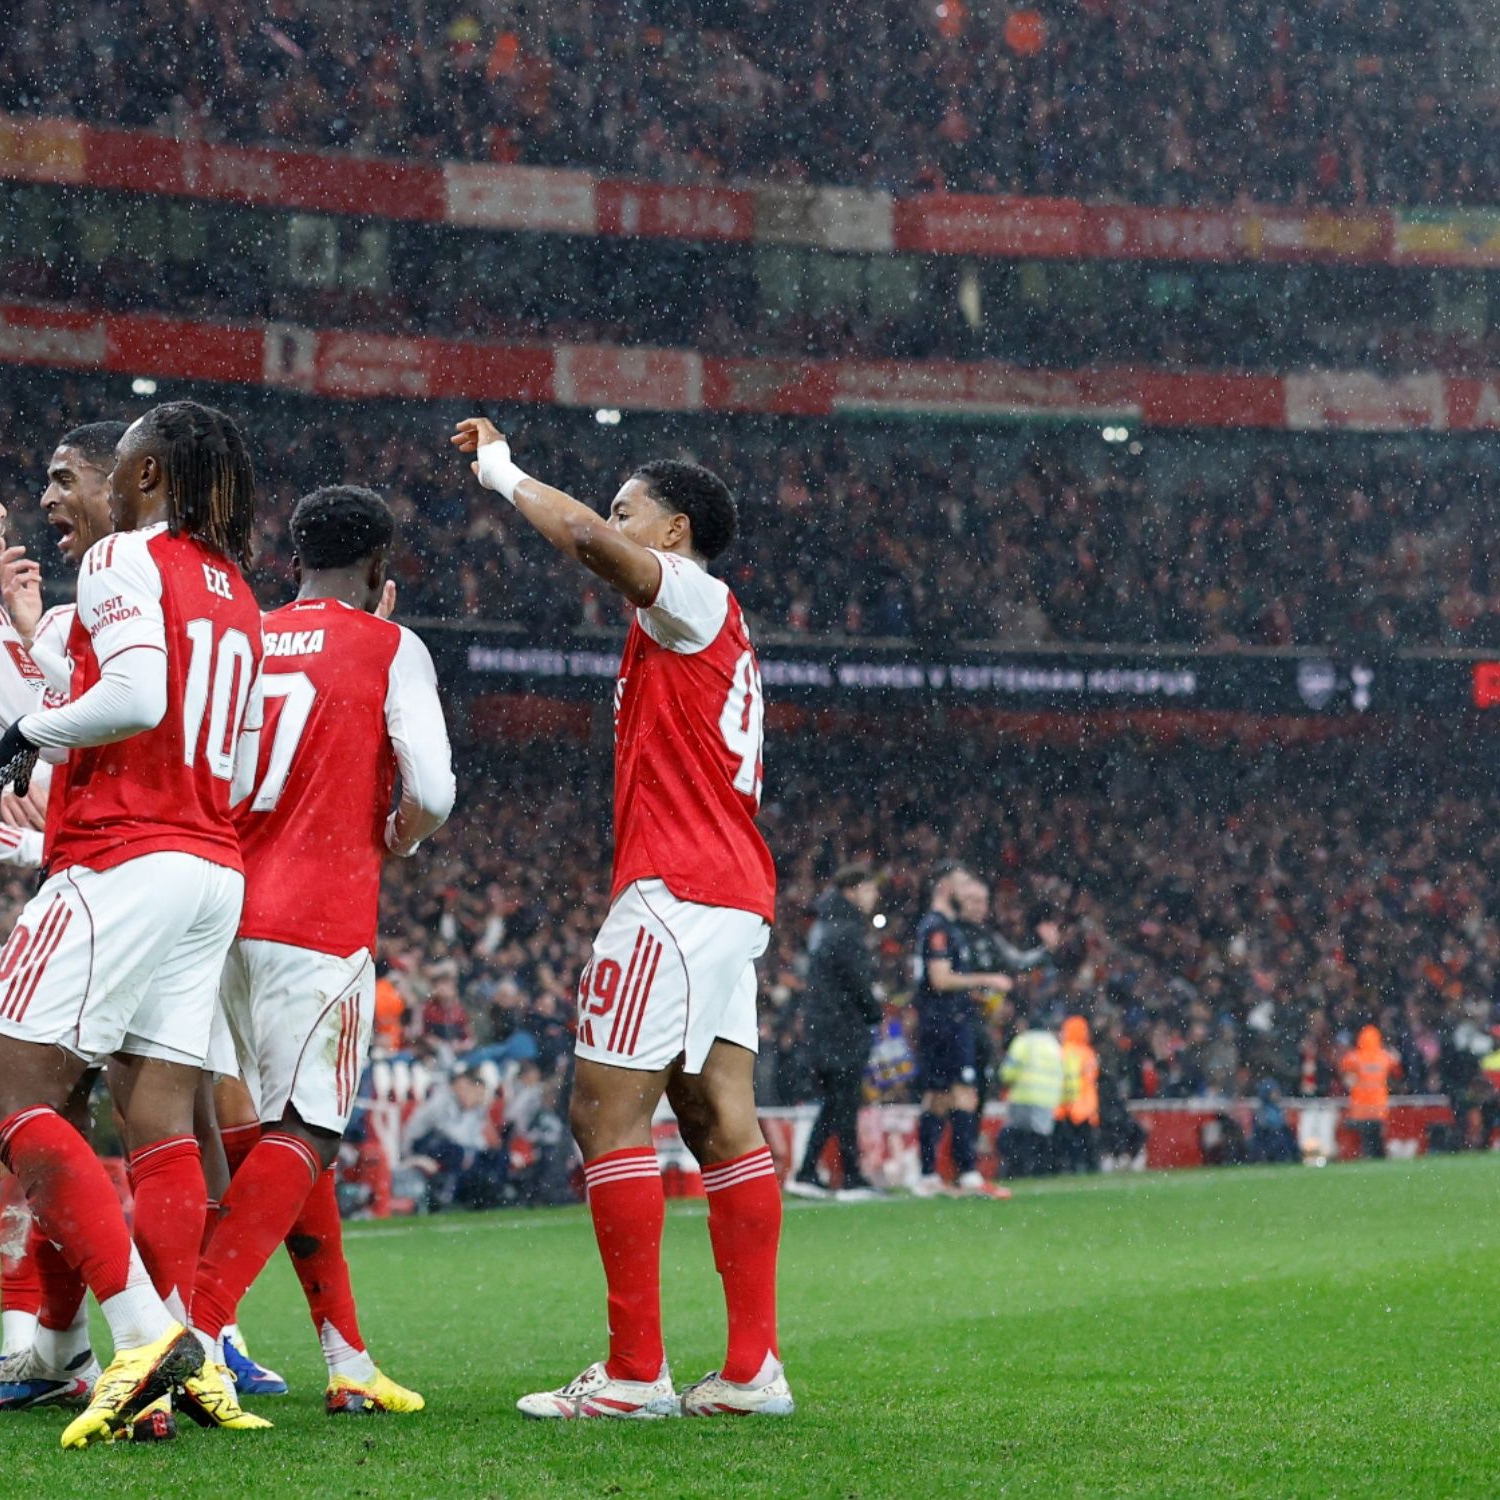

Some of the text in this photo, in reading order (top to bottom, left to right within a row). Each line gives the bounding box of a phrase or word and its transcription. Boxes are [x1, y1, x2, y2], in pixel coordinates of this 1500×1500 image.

[202, 563, 233, 600] EZE
[92, 595, 123, 619] VISIT
[263, 629, 325, 656] SAKA
[183, 617, 254, 781] 10
[250, 671, 318, 812] 7
